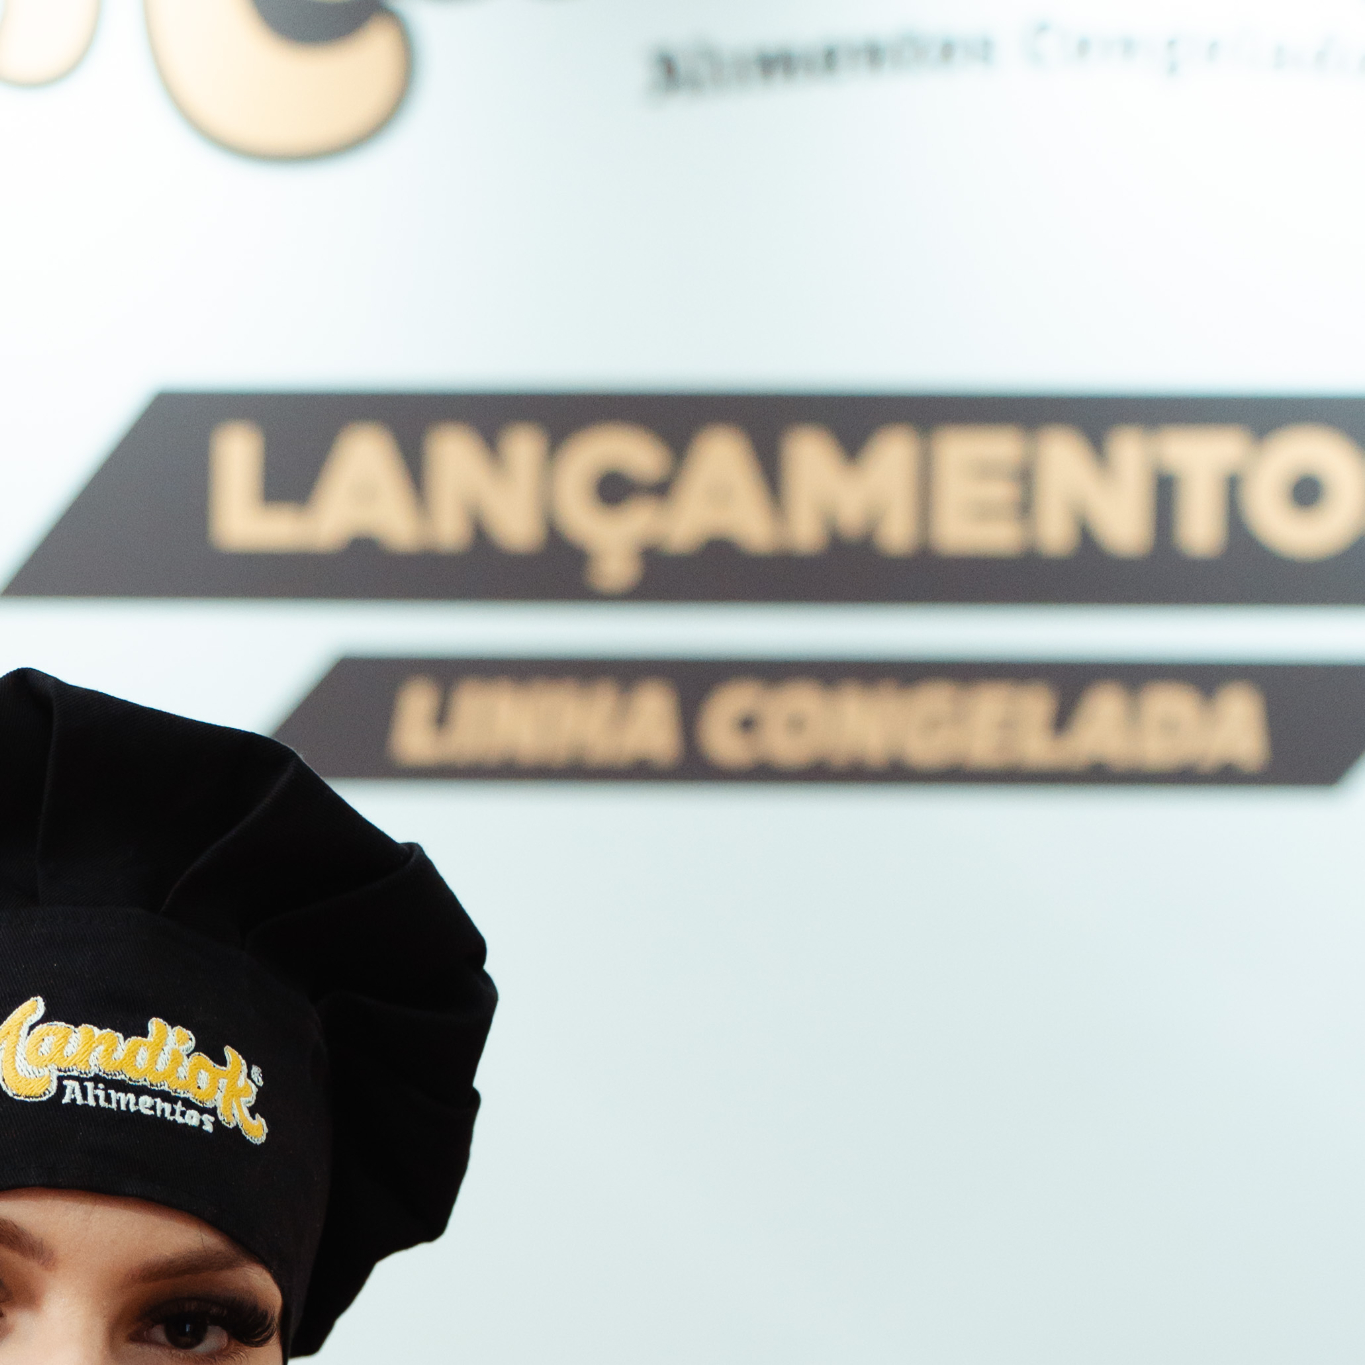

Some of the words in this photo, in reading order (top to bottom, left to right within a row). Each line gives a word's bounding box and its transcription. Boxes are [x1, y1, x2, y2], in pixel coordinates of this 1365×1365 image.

[208, 419, 1365, 594] LANÇAMENTO
[387, 672, 684, 770] LINHA
[694, 674, 1272, 775] CONGELADA
[61, 1079, 216, 1134] Alimentos
